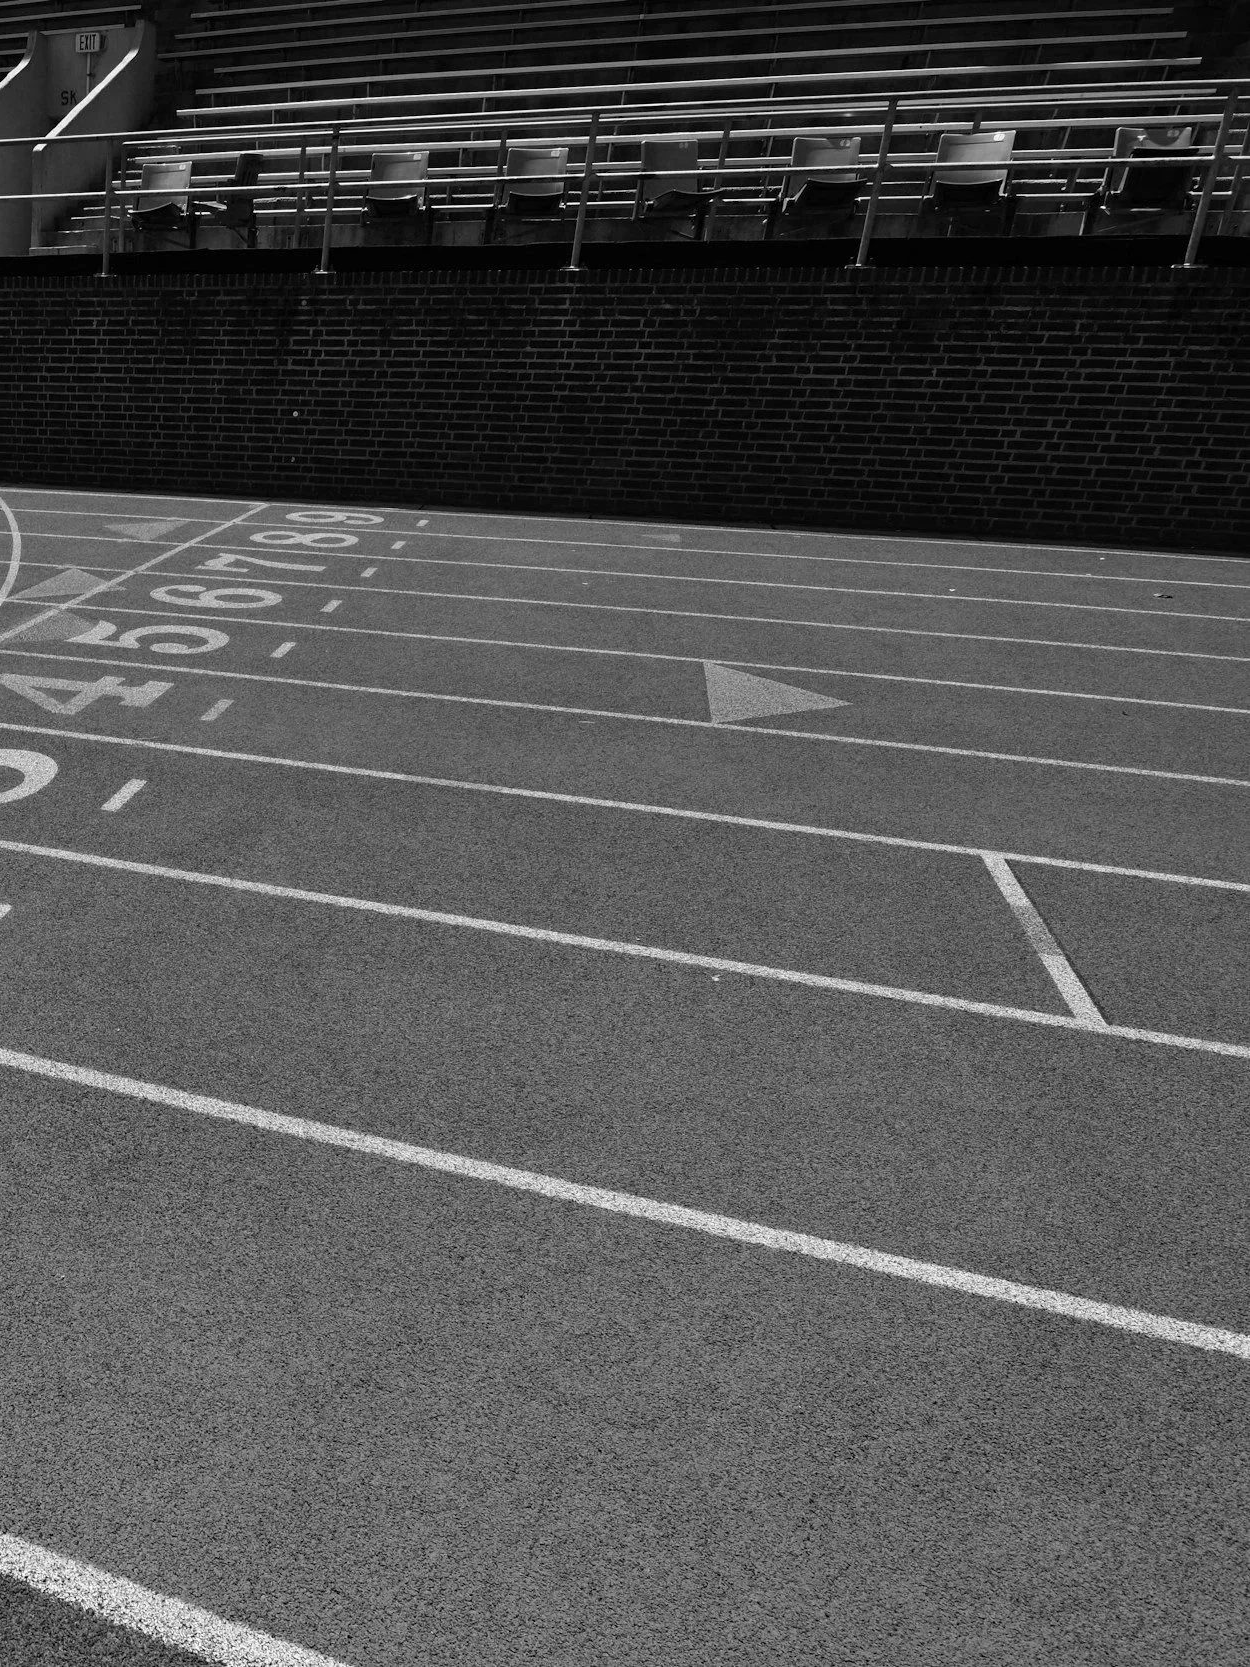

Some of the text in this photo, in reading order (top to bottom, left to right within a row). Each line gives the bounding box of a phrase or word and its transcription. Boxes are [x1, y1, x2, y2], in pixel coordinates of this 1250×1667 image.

[79, 34, 97, 51] EXIT
[286, 511, 384, 525] 9
[250, 531, 358, 547] 8
[196, 553, 326, 572] 7
[150, 585, 282, 608] 6
[65, 620, 229, 654] 5
